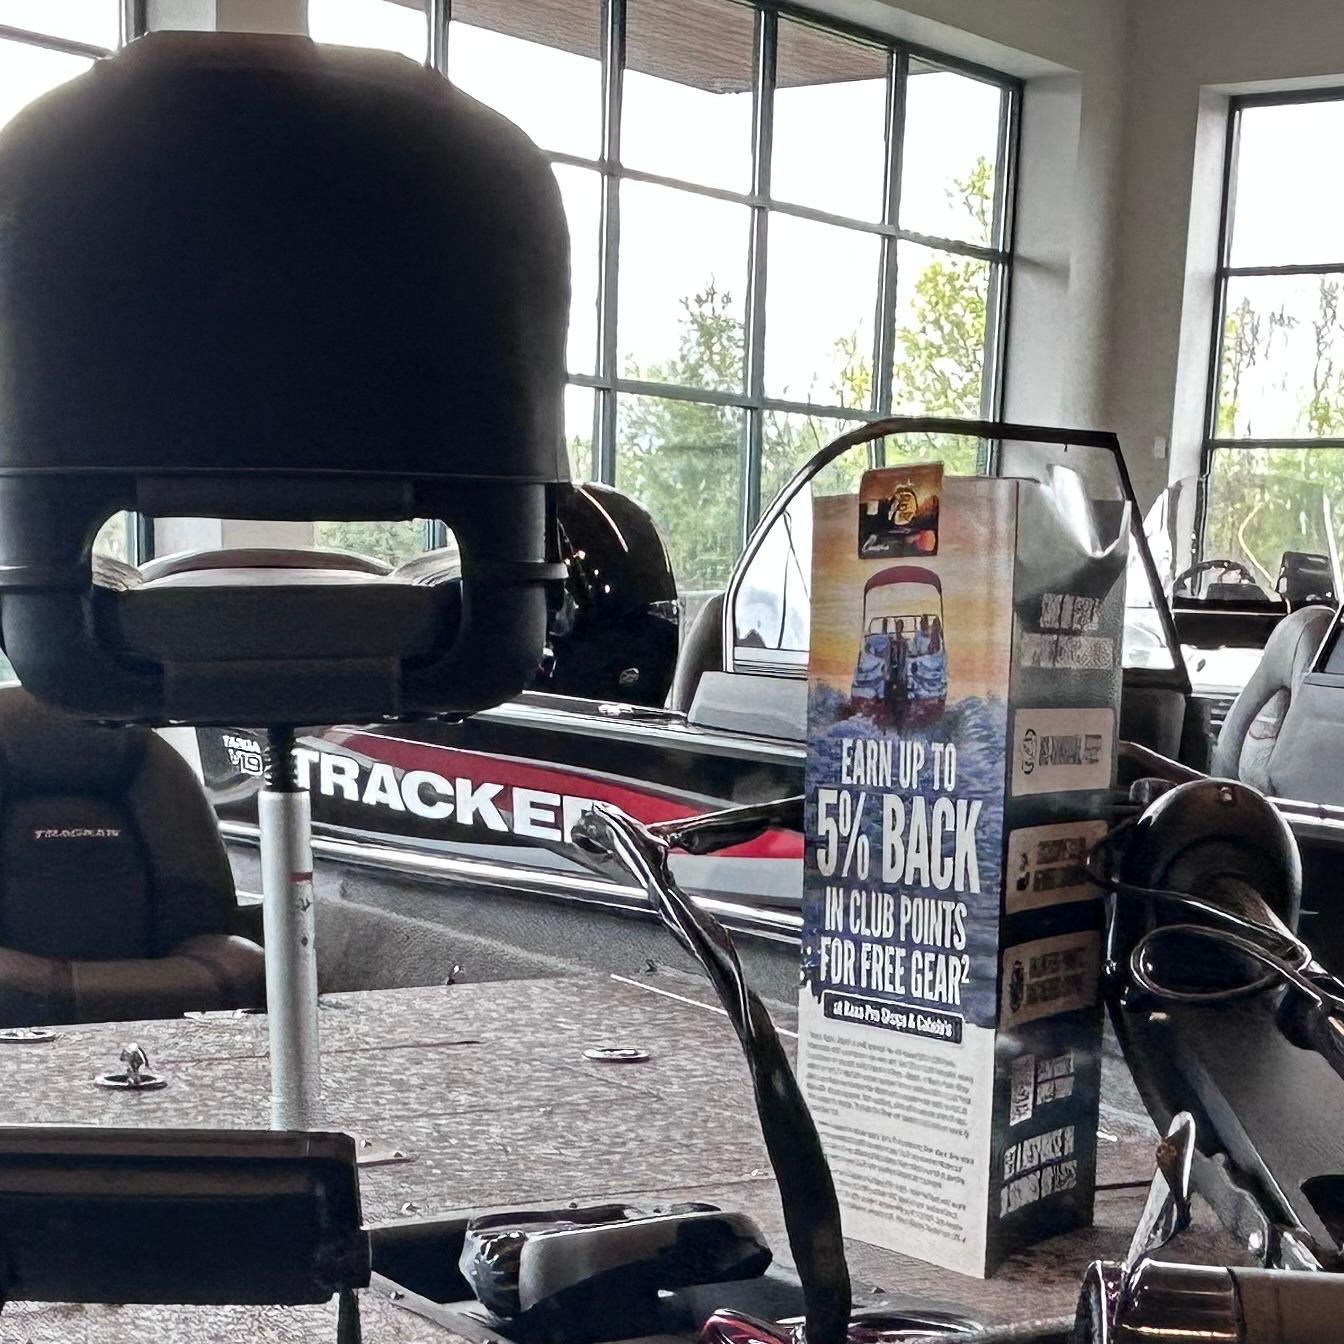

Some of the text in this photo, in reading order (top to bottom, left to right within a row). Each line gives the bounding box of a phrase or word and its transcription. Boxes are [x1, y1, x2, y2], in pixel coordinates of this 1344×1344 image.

[841, 738, 957, 792] EARN UP TO
[816, 788, 870, 881] 5%
[882, 793, 983, 894] BACK
[824, 886, 968, 951] IN CLUB POINTS
[820, 936, 856, 986] FOR
[861, 942, 906, 995] FREE
